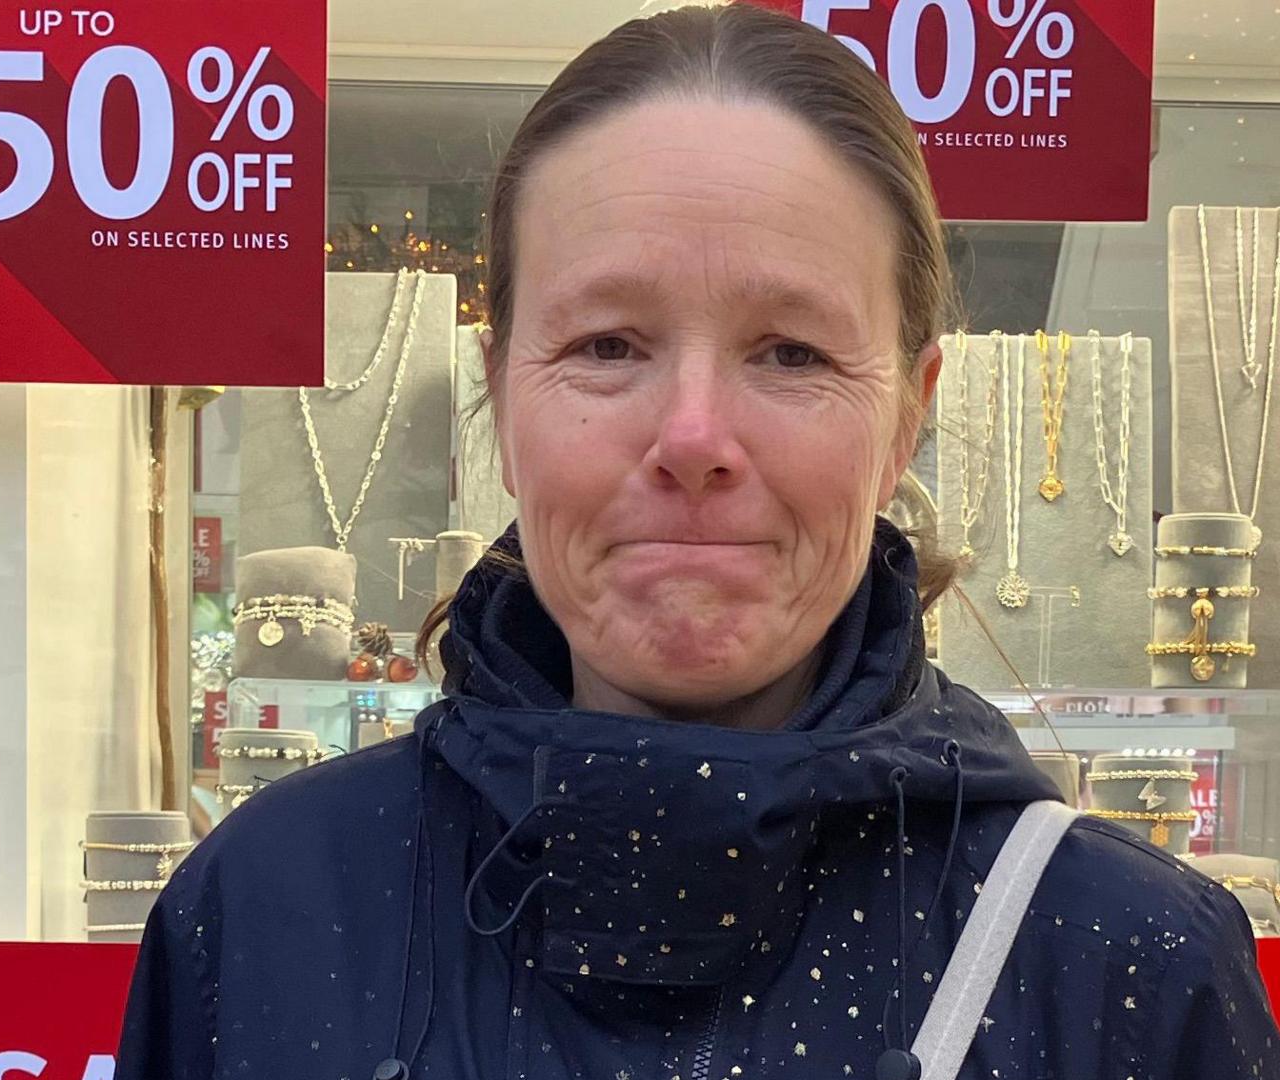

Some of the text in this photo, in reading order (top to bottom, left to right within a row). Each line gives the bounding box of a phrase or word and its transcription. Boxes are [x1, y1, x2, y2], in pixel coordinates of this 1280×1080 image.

[20, 10, 115, 37] UP TO
[985, 67, 1073, 118] OFF
[934, 132, 1015, 148] SELECTED
[1020, 134, 1068, 149] LINES
[187, 152, 293, 213] OFF
[90, 230, 290, 250] ON SELECTED LINES
